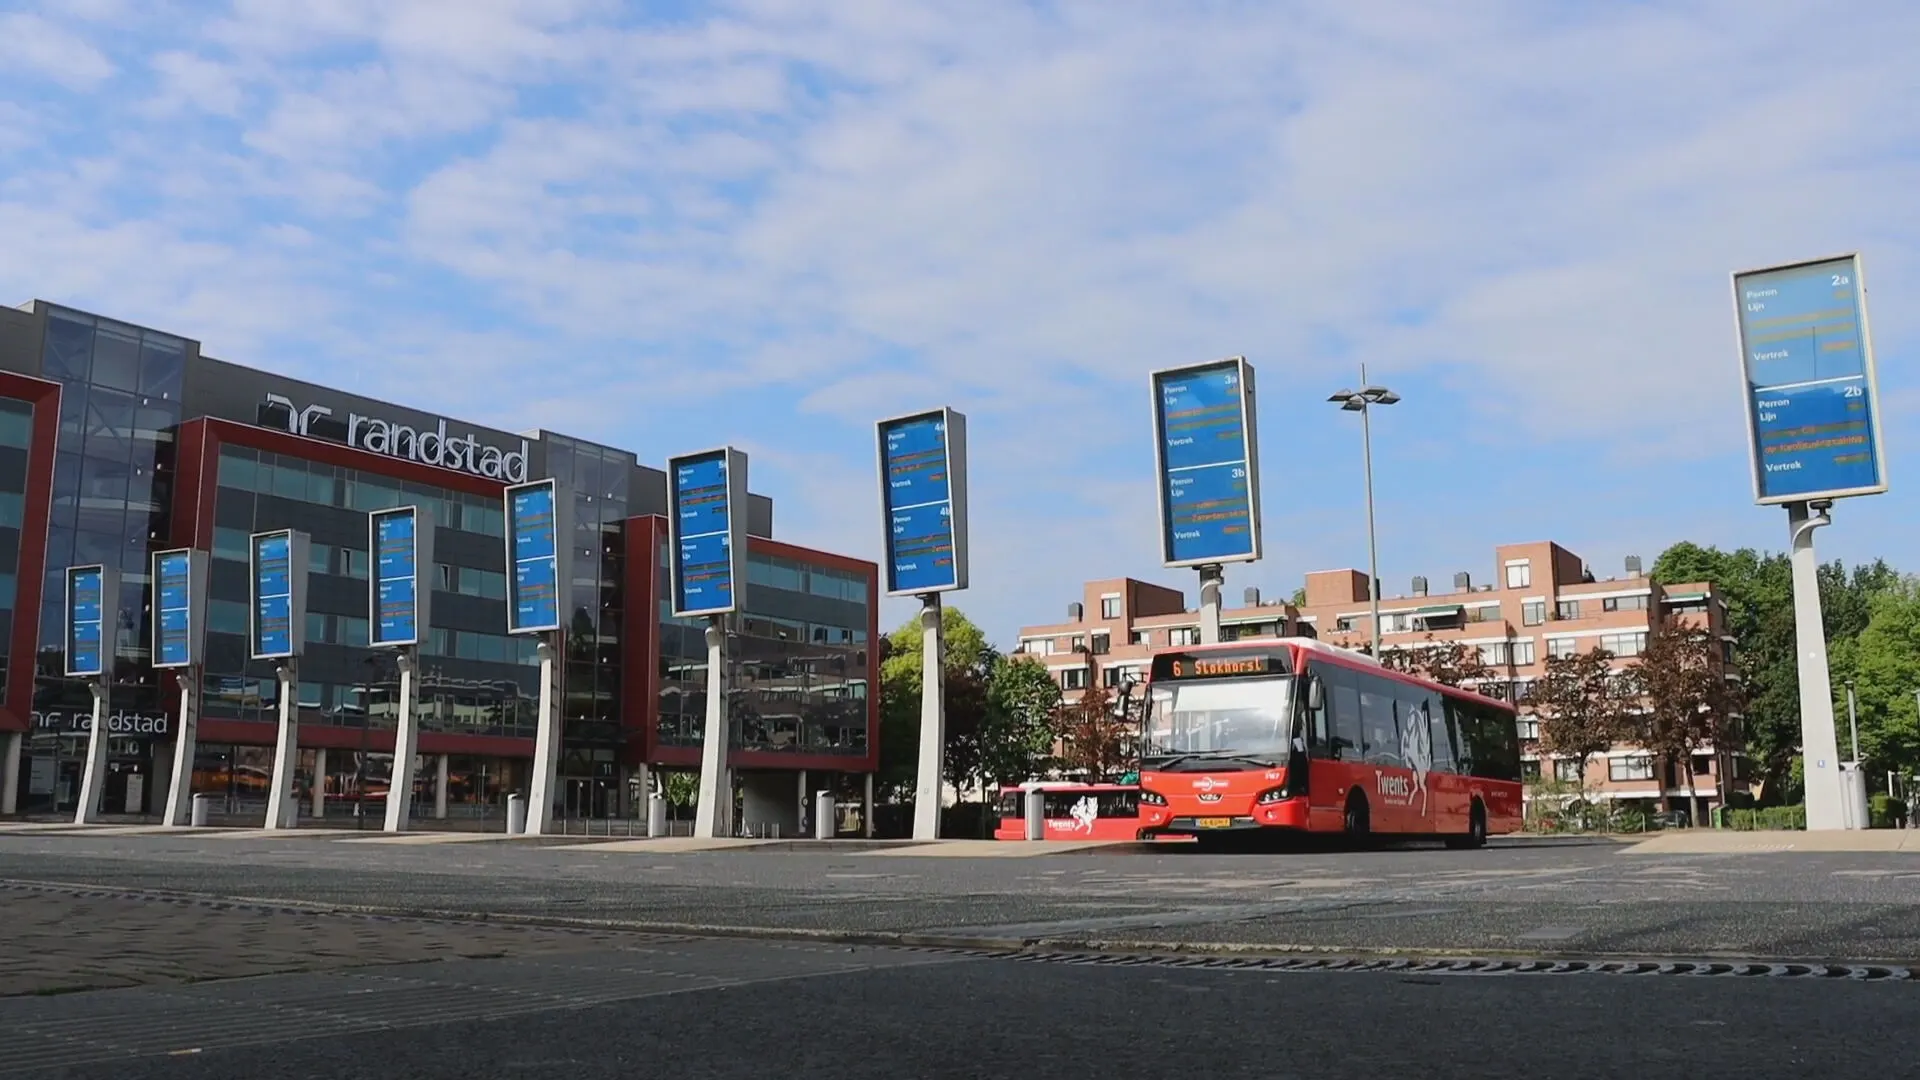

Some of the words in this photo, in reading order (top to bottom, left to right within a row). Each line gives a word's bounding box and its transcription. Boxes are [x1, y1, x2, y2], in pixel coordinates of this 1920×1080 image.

[1832, 275, 1849, 286] 2a
[1747, 288, 1778, 298] Perron
[1748, 302, 1764, 312] Lijn
[1754, 349, 1789, 361] Vertrek
[1225, 375, 1237, 385] 3a
[1844, 386, 1862, 398] 2b
[1759, 398, 1790, 408] Perron
[1760, 412, 1776, 422] Lijn
[348, 413, 528, 483] randstad
[1766, 462, 1802, 473] Vertrek
[1232, 469, 1244, 478] 3b
[1173, 661, 1181, 677] 6
[1195, 656, 1261, 675] Stokhorst
[72, 710, 167, 733] radstad
[1375, 770, 1408, 796] Twents
